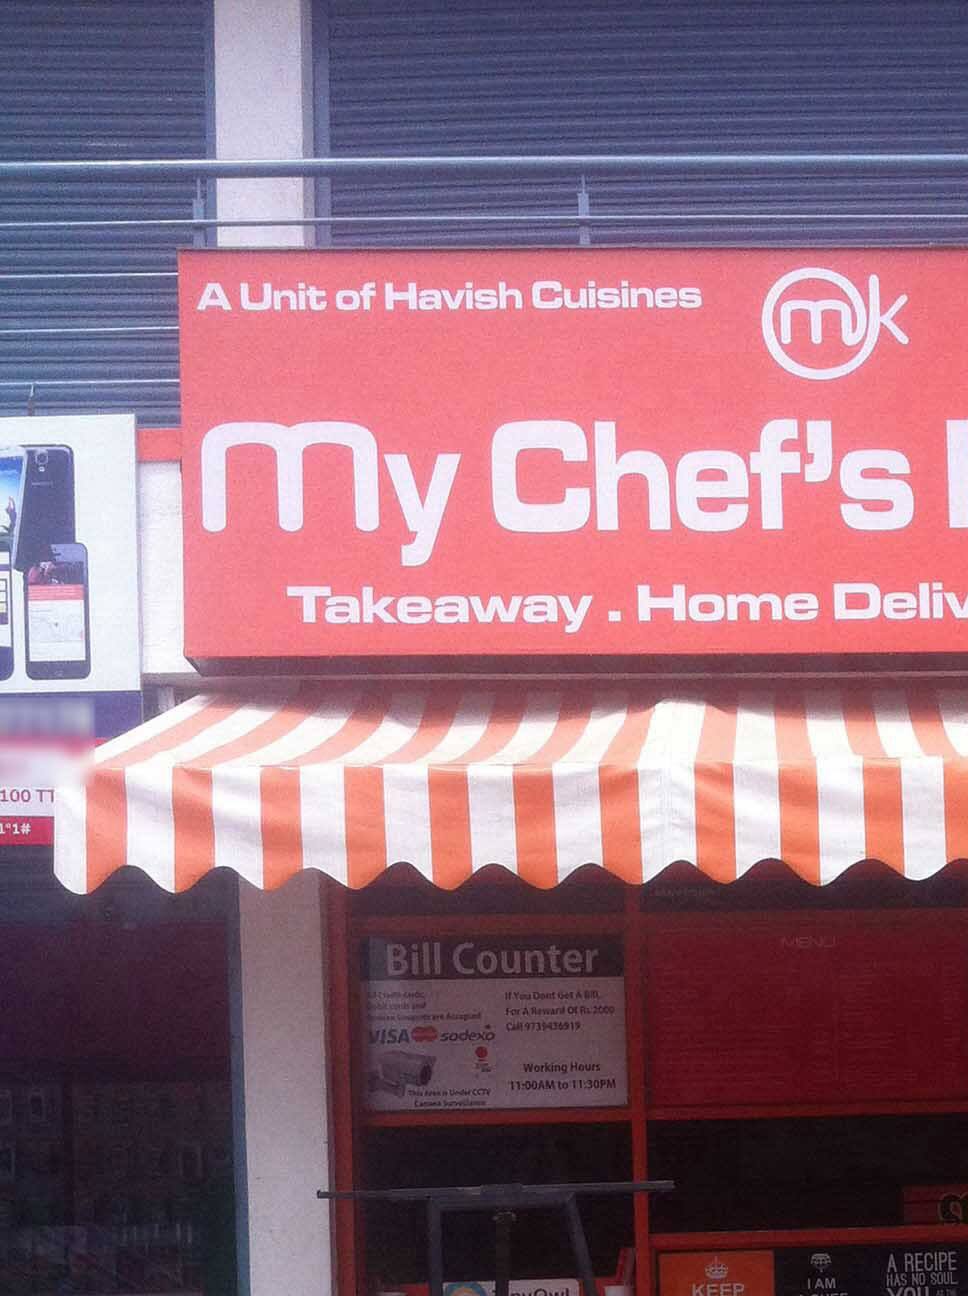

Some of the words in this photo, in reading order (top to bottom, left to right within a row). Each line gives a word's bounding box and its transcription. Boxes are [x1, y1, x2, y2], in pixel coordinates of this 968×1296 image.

[197, 283, 234, 312] A
[240, 283, 329, 312] Unit
[336, 282, 378, 312] of
[385, 282, 523, 312] Havish
[532, 281, 703, 311] Cuisines
[201, 421, 463, 568] My
[491, 419, 916, 534] Chef's
[287, 586, 594, 635] Takeaway
[637, 584, 820, 623] Home
[780, 935, 838, 949] MENU
[386, 941, 441, 976] Bill
[452, 941, 600, 976] Counter
[513, 991, 531, 1000] You
[505, 1007, 520, 1016] For
[522, 1007, 529, 1015] A
[368, 1028, 410, 1045] VISA
[440, 1028, 496, 1042] sodexo
[523, 1062, 568, 1074] Working
[570, 1061, 601, 1072] Hours
[557, 1079, 569, 1089] to
[887, 1253, 898, 1273] A
[903, 1251, 958, 1273] RECIPE
[814, 1277, 837, 1290] AM
[886, 1272, 908, 1288] HAS
[911, 1272, 926, 1287] NO
[929, 1271, 959, 1287] SOUL
